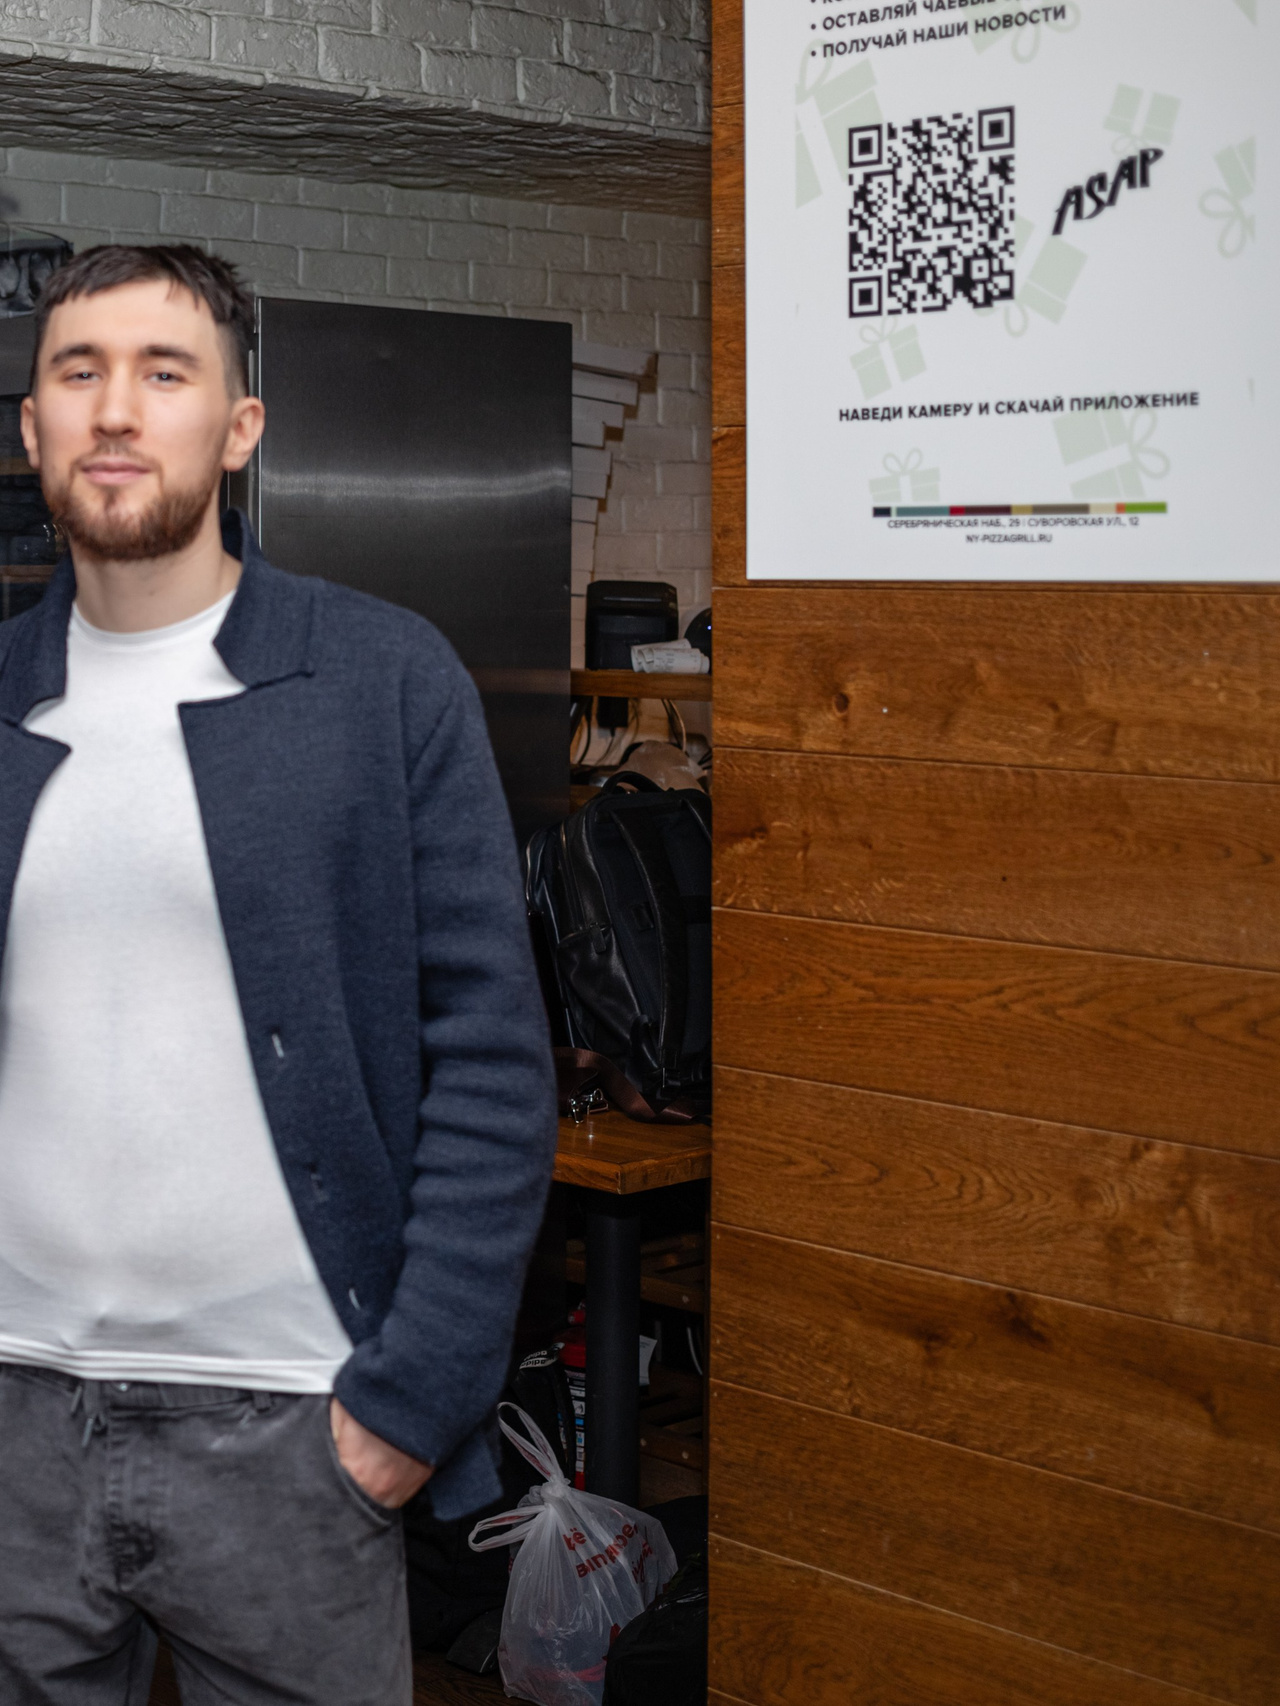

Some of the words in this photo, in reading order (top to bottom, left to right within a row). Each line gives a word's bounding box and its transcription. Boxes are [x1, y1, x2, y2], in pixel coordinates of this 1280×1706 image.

[822, 0, 917, 30] ОСТАВЛЯЙ
[822, 29, 907, 58] ПОЛУЧАЙ
[913, 21, 968, 43] НАШИ
[974, 5, 1066, 33] НОВОСТИ
[1052, 148, 1164, 236] ASAP
[838, 407, 902, 422] НАВЕДИ
[908, 402, 973, 419] КАМЕРУ
[978, 401, 989, 415] И
[995, 396, 1064, 414] СКАЧАЙ
[1070, 391, 1200, 411] ПРИЛОЖЕНИЕ
[1008, 518, 1021, 527] 29
[1027, 517, 1103, 527] СУВОРОВСКАЯ
